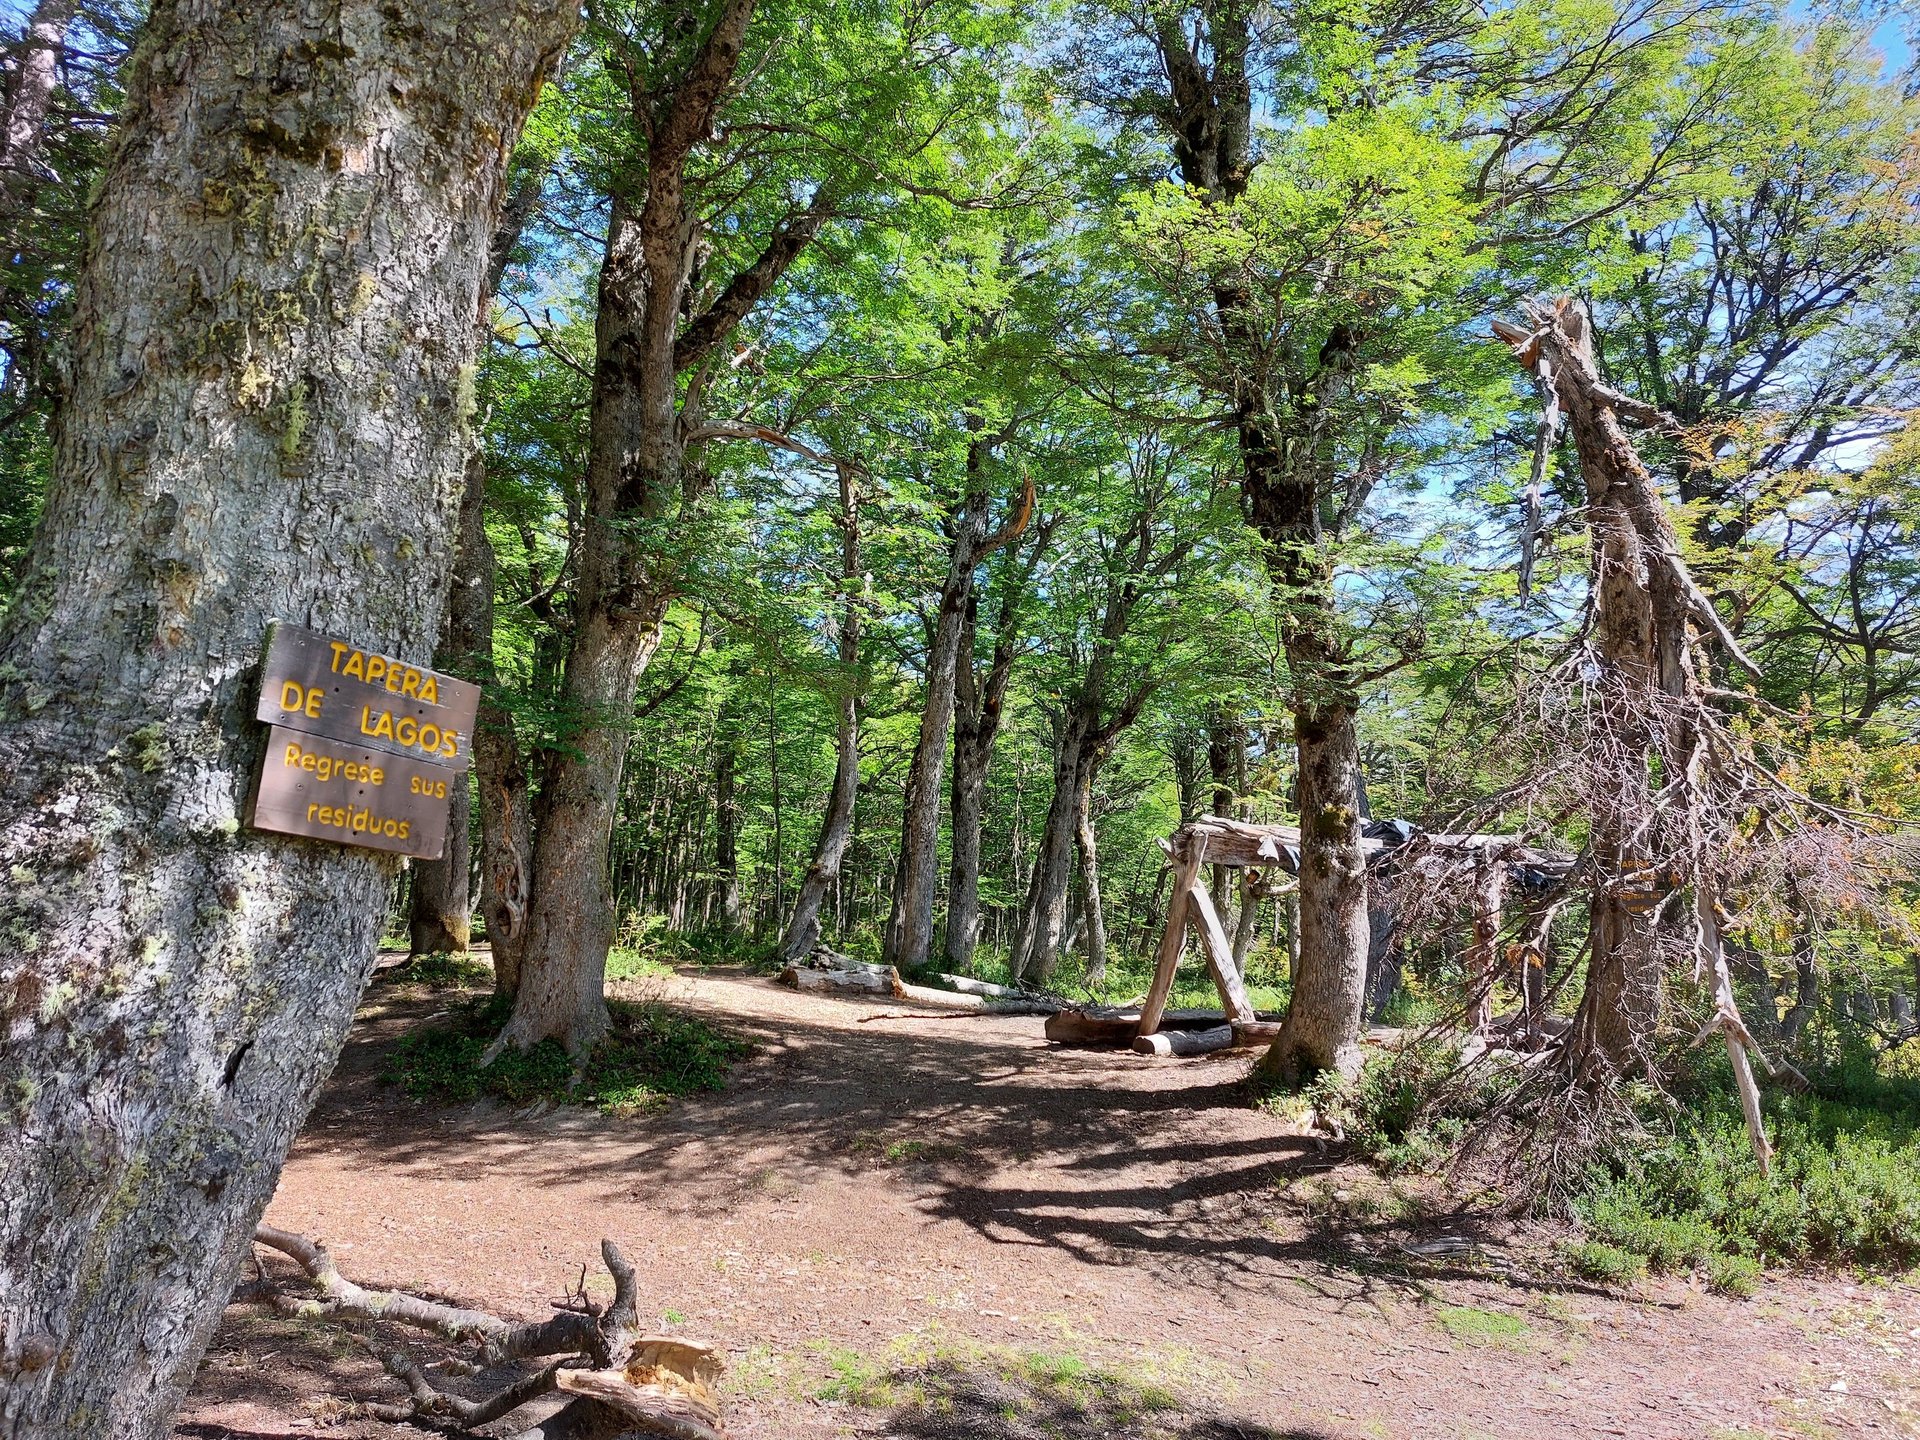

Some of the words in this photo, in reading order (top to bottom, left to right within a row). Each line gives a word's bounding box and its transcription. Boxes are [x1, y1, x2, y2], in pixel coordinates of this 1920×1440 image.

[330, 640, 438, 705] TAPERA
[280, 679, 324, 718] DE
[360, 704, 458, 758] LAGOS
[284, 742, 384, 785] Regrese
[410, 775, 446, 799] sus
[307, 803, 411, 839] residuos
